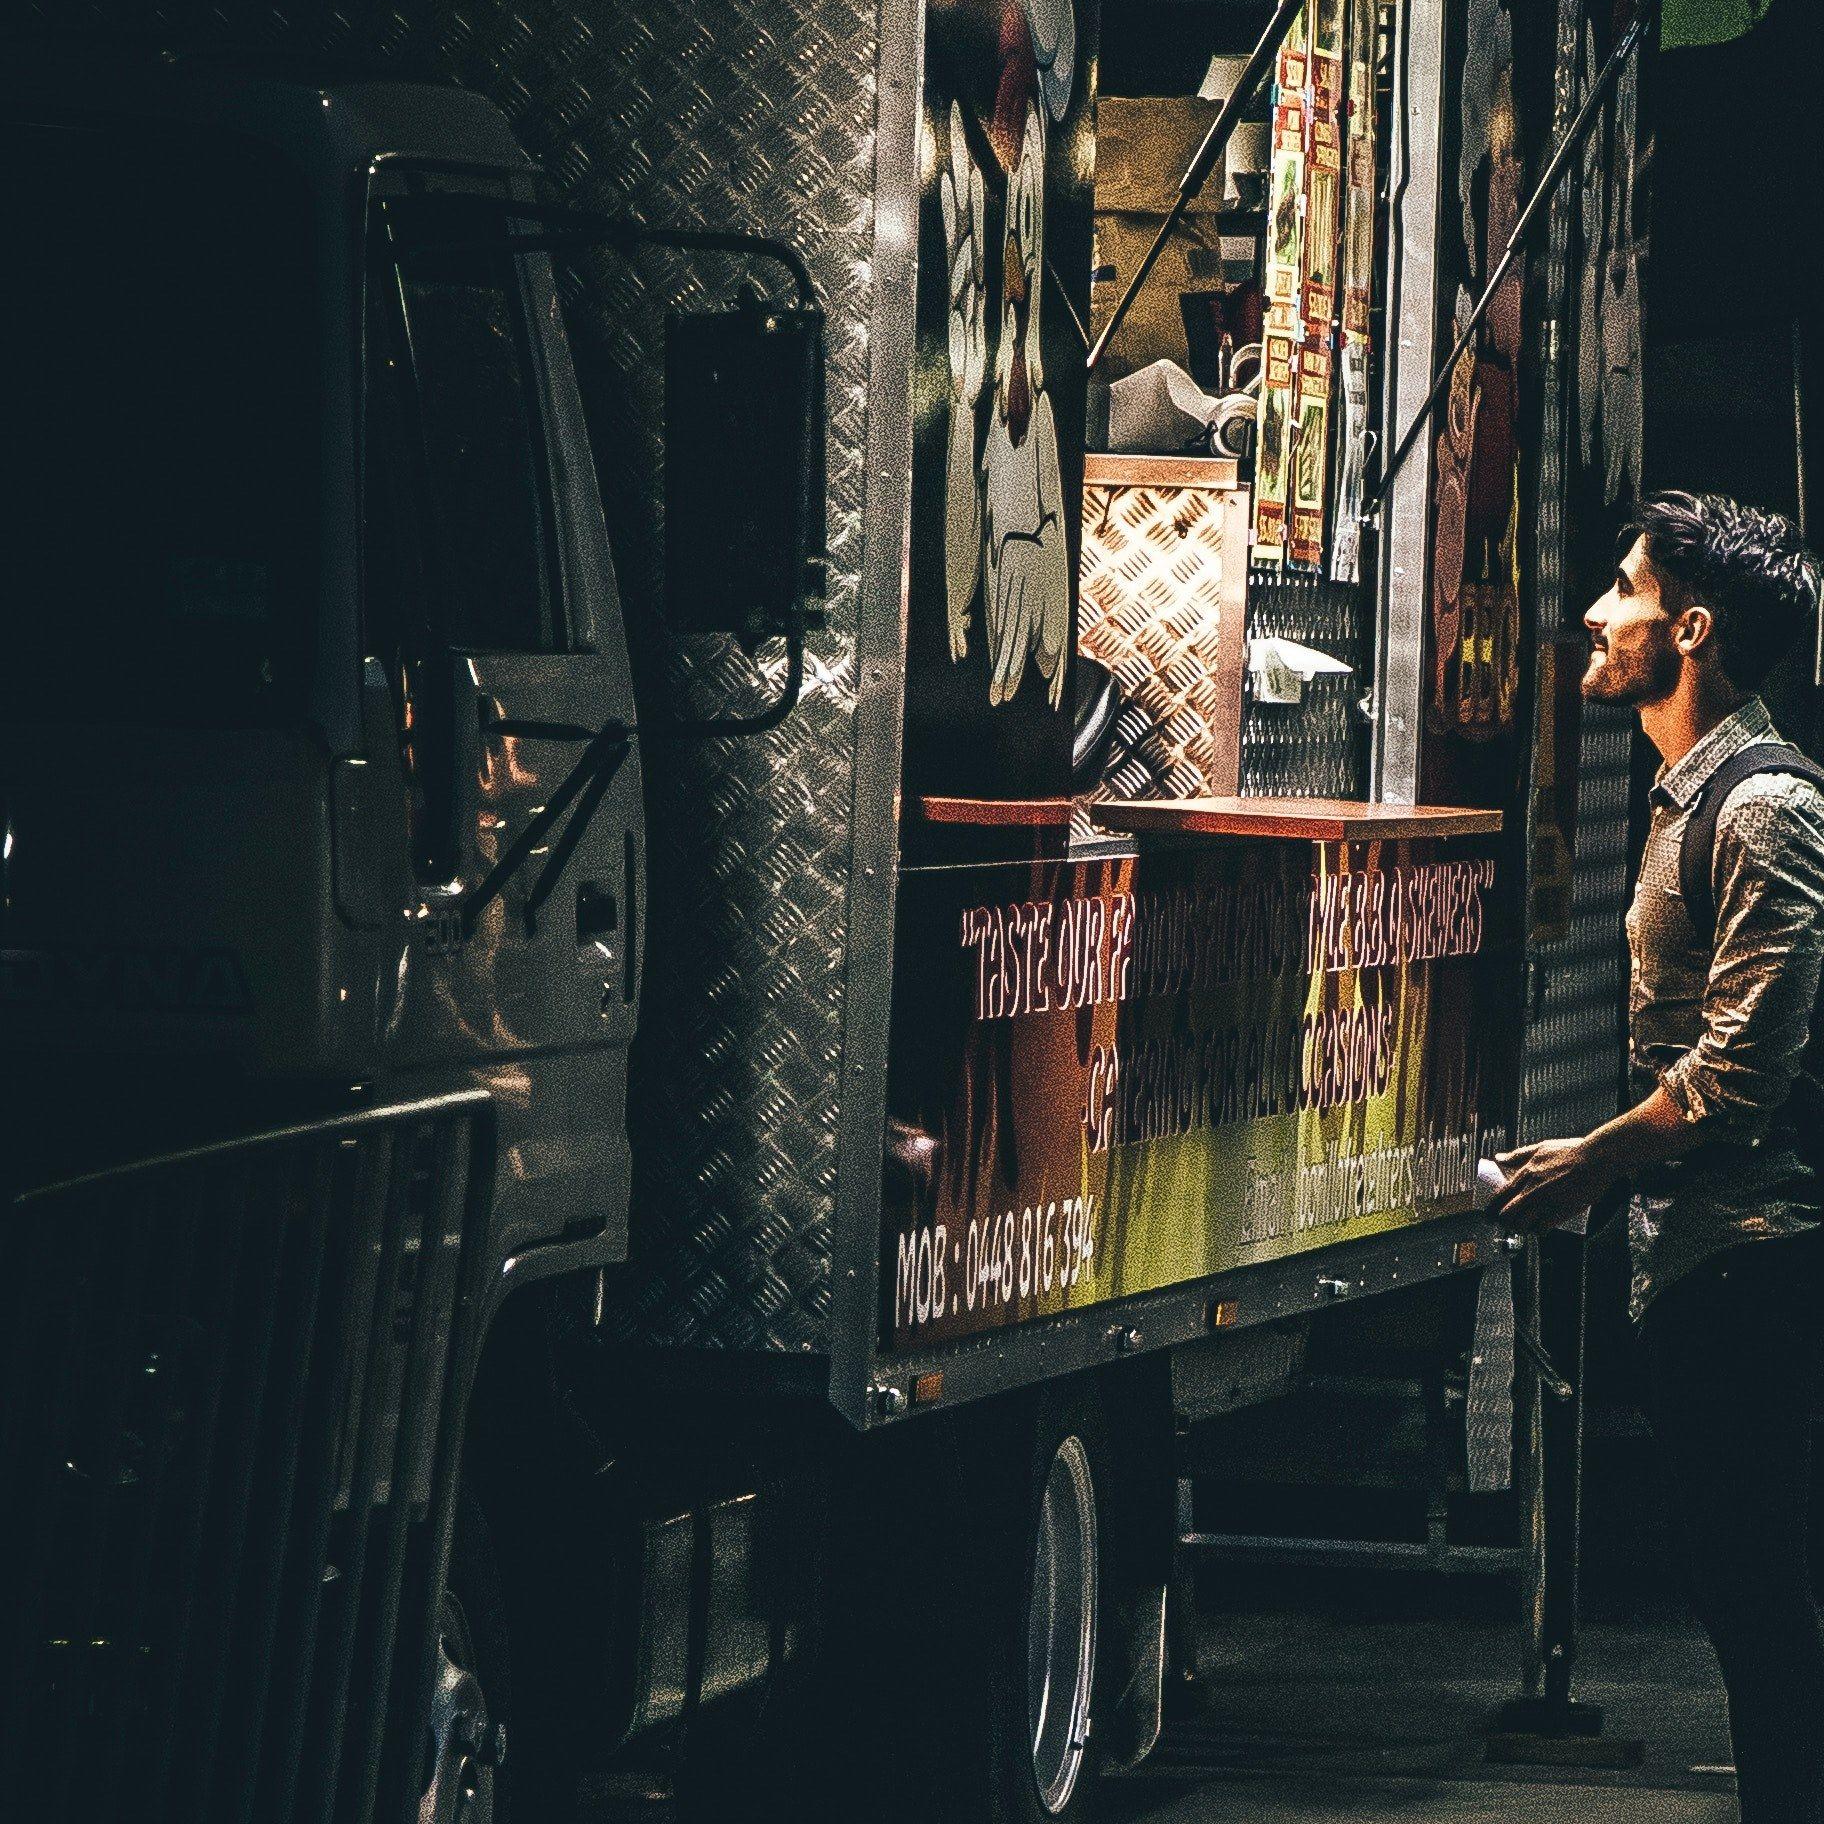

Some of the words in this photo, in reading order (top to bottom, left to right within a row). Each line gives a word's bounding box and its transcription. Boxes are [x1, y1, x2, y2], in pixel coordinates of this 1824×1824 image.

[1057, 897, 1105, 1010] OUR
[966, 1210, 1014, 1313] 0448
[1018, 1201, 1056, 1300] 816
[1060, 1194, 1094, 1289] 394
